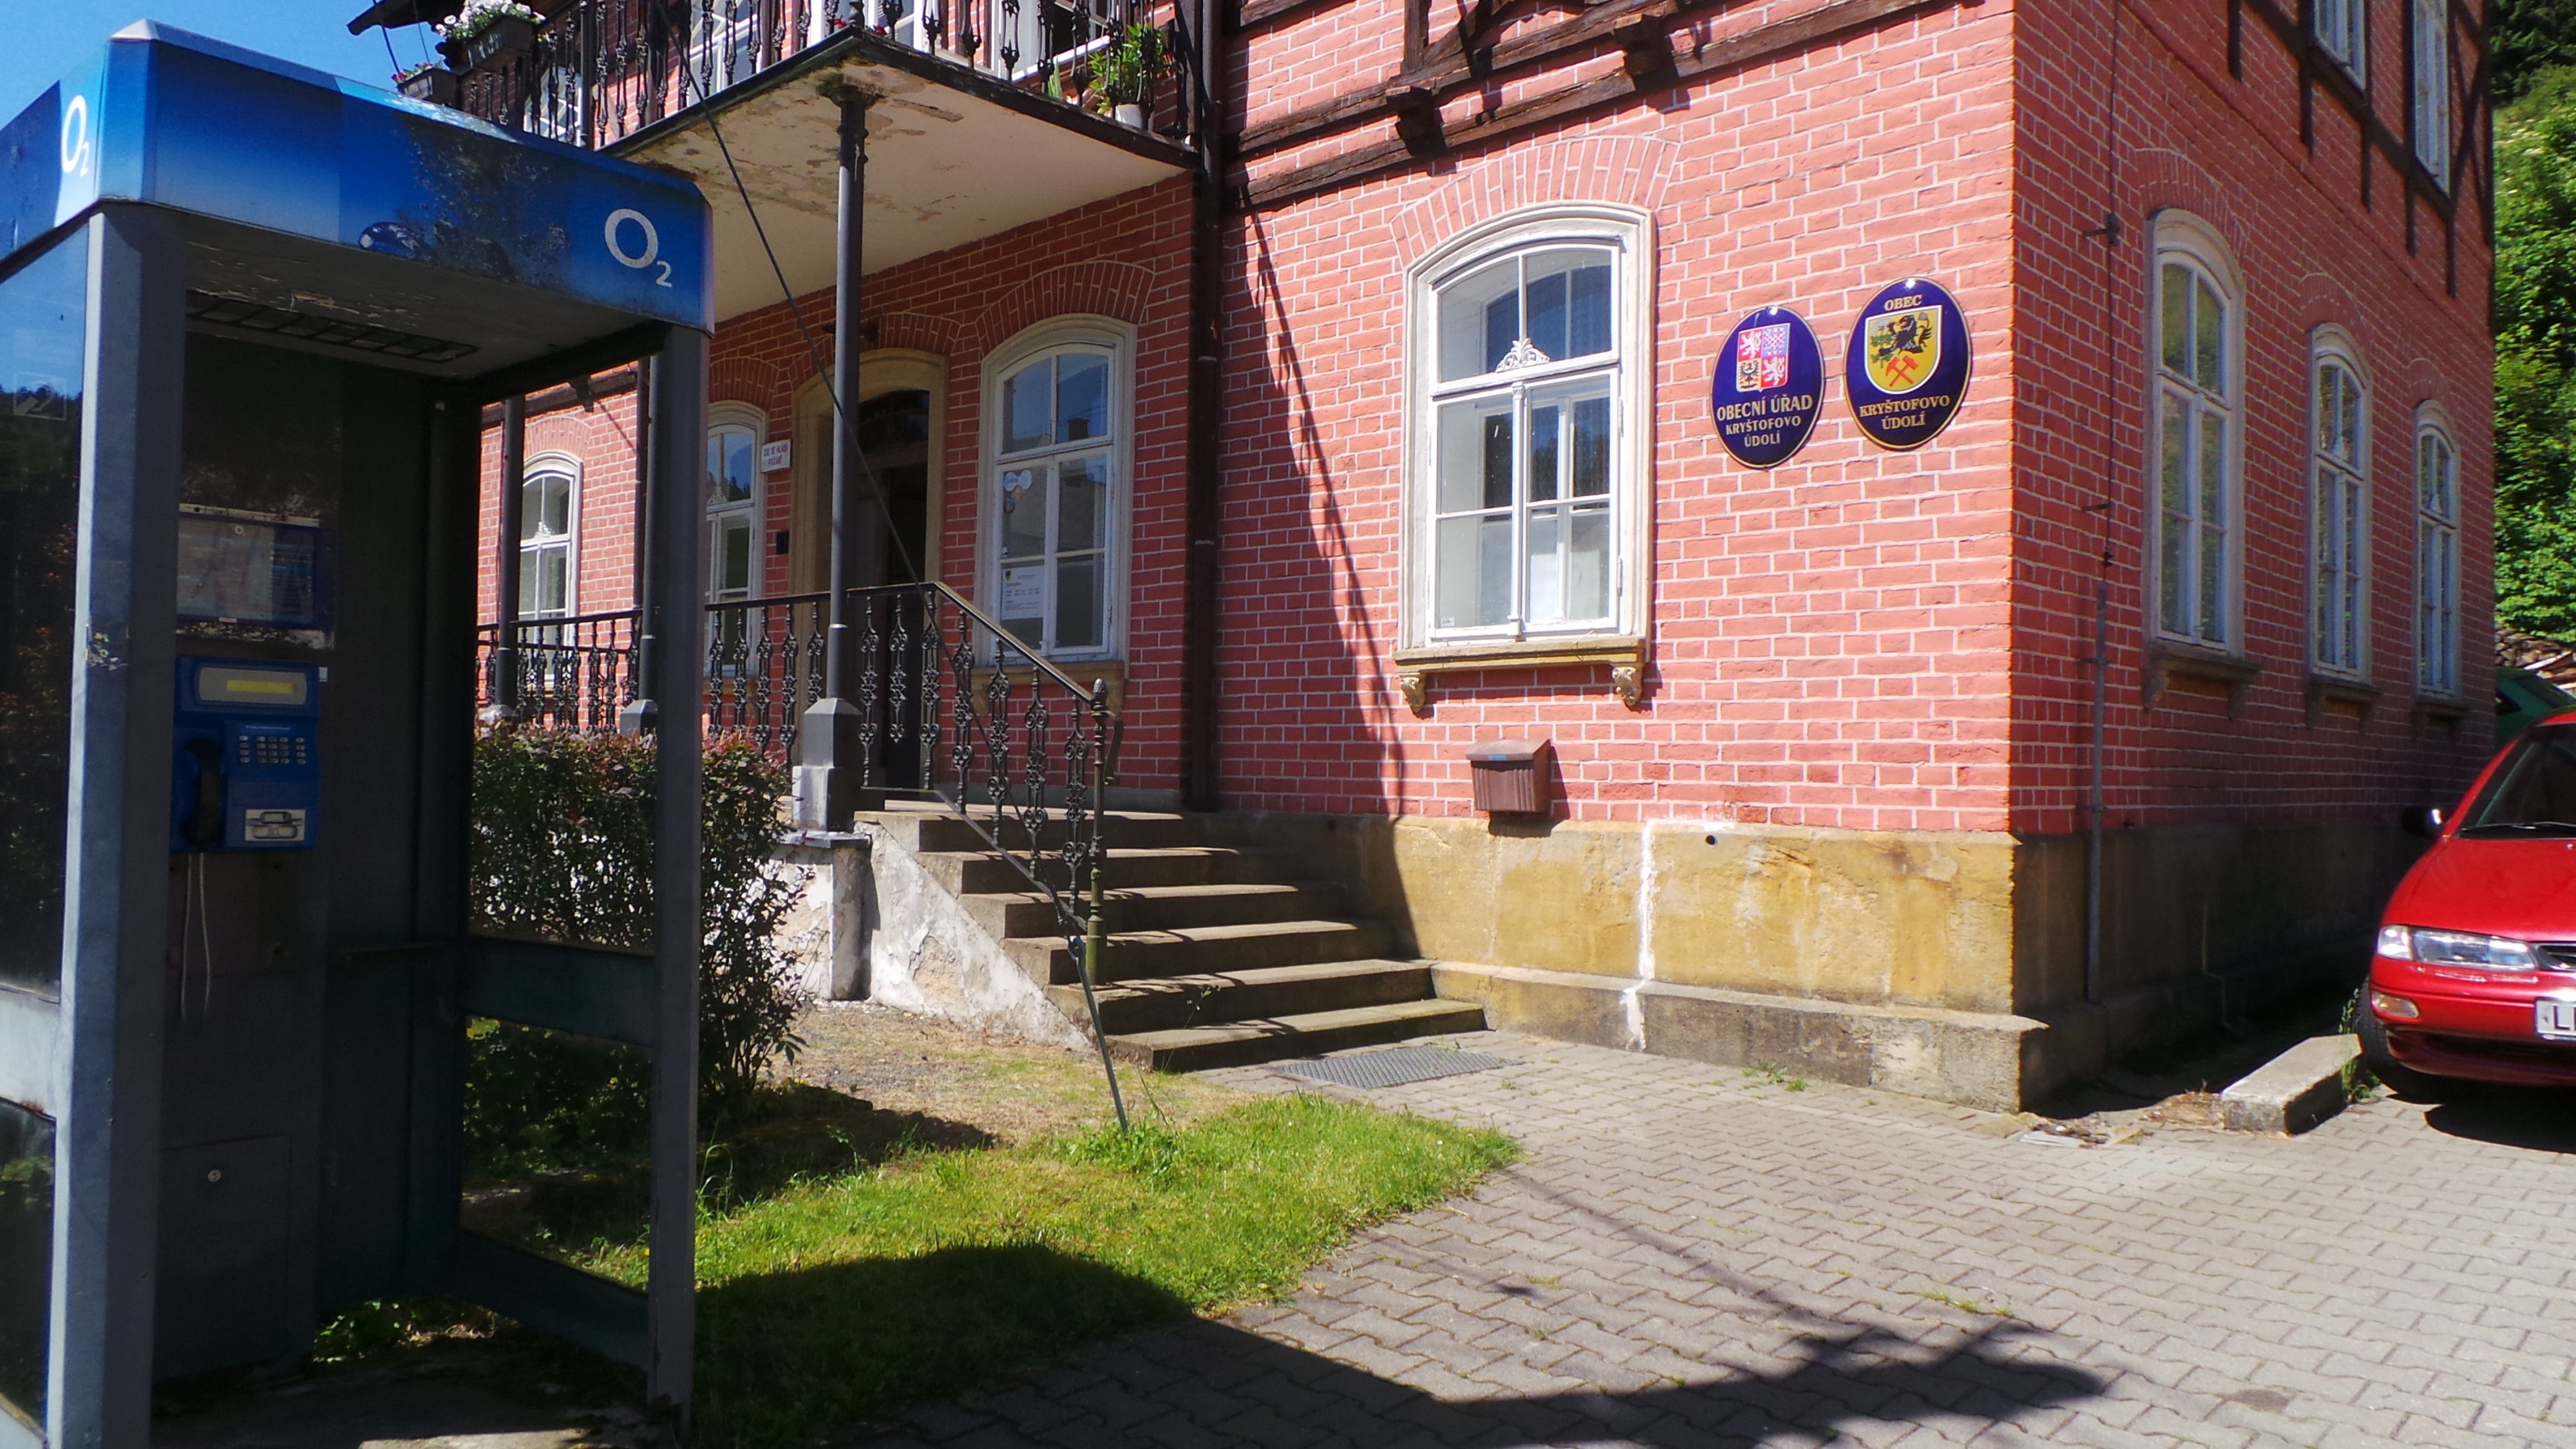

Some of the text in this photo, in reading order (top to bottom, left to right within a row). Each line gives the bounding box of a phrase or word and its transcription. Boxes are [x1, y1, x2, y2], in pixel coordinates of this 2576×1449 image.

[1884, 294, 1922, 311] OBEC
[1716, 394, 1813, 421] OBECNÍ ÚŘAD
[1859, 395, 1950, 417] KRYŠTOFOVO
[1726, 415, 1801, 435] KRYŠTOFOVO
[1881, 411, 1926, 430] ÚDOLÍ
[1744, 430, 1781, 448] ÚDOLÍ
